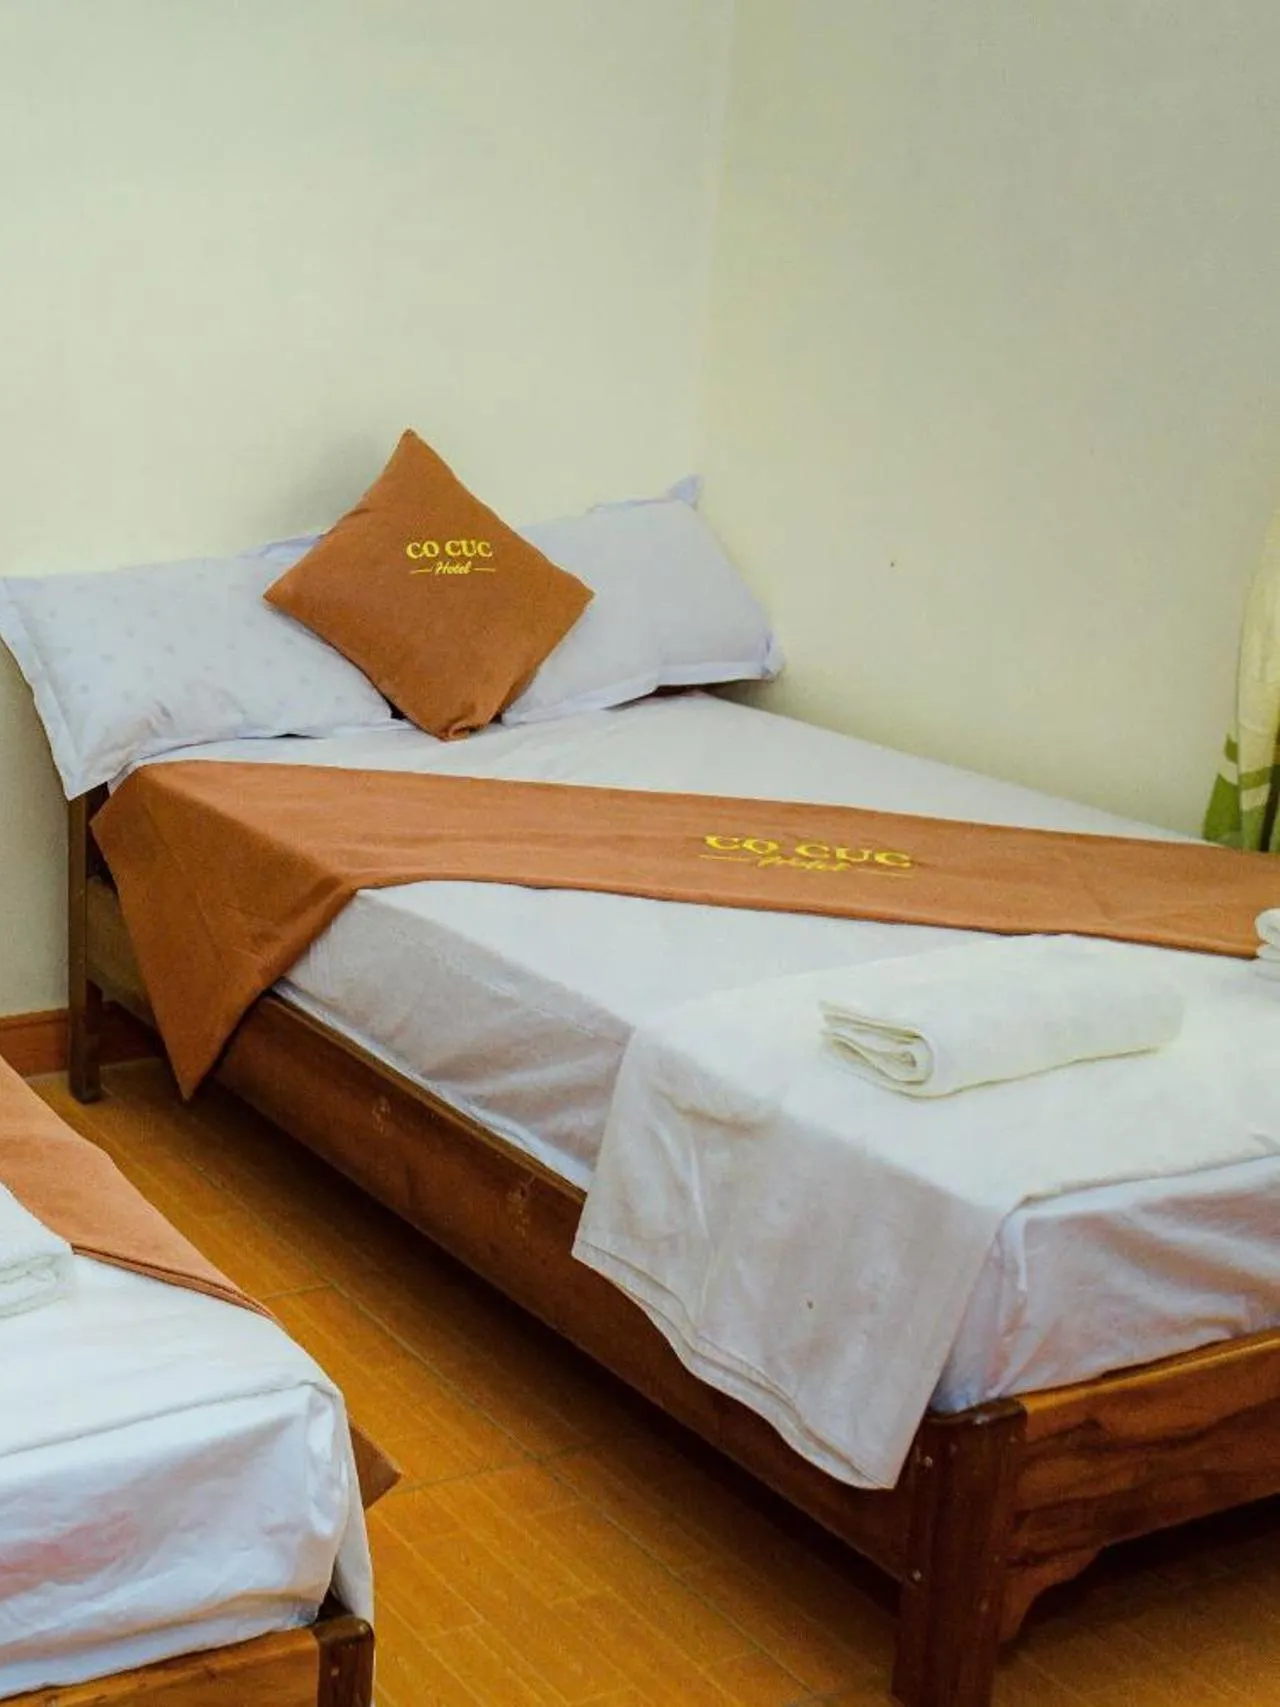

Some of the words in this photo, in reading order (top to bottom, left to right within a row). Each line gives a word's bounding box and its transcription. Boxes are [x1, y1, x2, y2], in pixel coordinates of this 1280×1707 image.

[406, 541, 440, 559] CO
[445, 540, 493, 557] CUC
[435, 560, 472, 575] Hotel
[704, 835, 780, 854] CO
[794, 844, 913, 868] CUC
